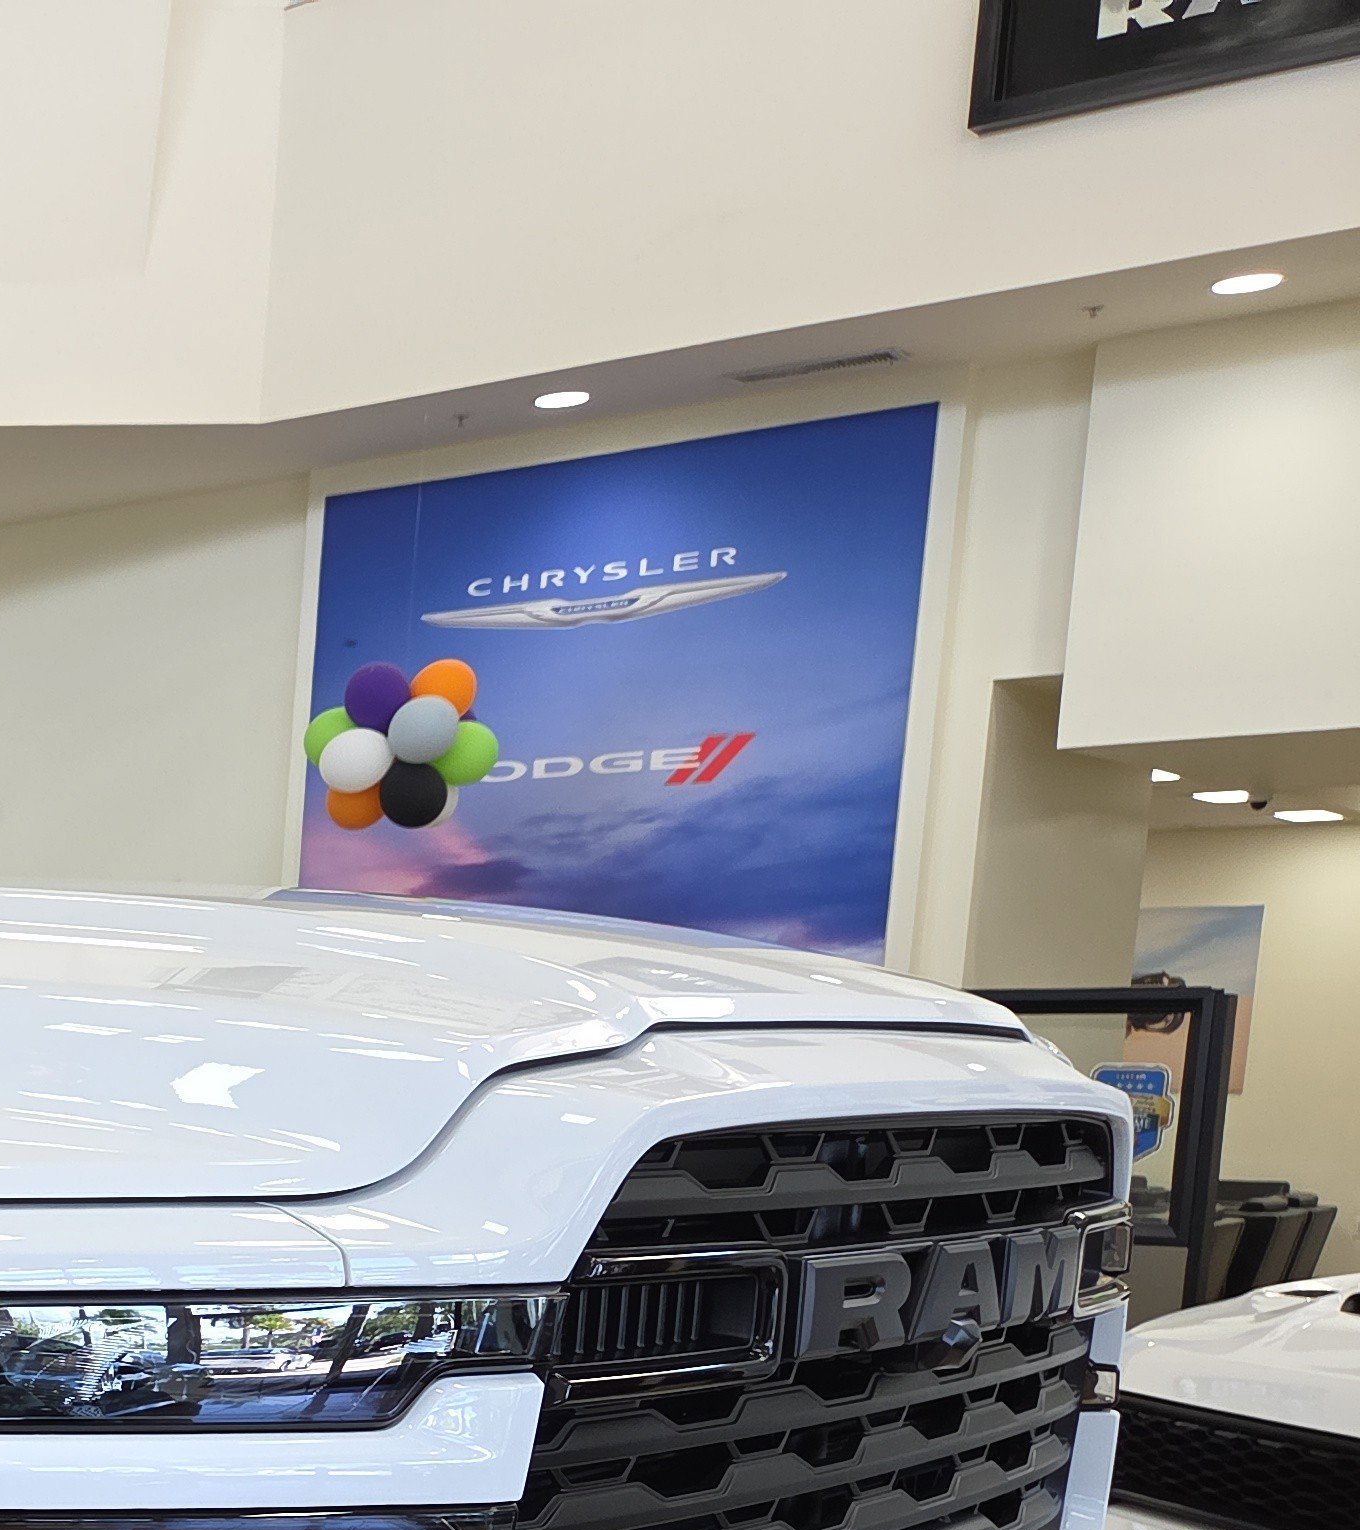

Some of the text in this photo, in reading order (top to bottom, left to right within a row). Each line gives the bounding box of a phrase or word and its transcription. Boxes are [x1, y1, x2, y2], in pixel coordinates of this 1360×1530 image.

[467, 547, 737, 597] CHRYSLER
[480, 746, 701, 783] ODGE
[797, 1224, 1082, 1361] RAM
